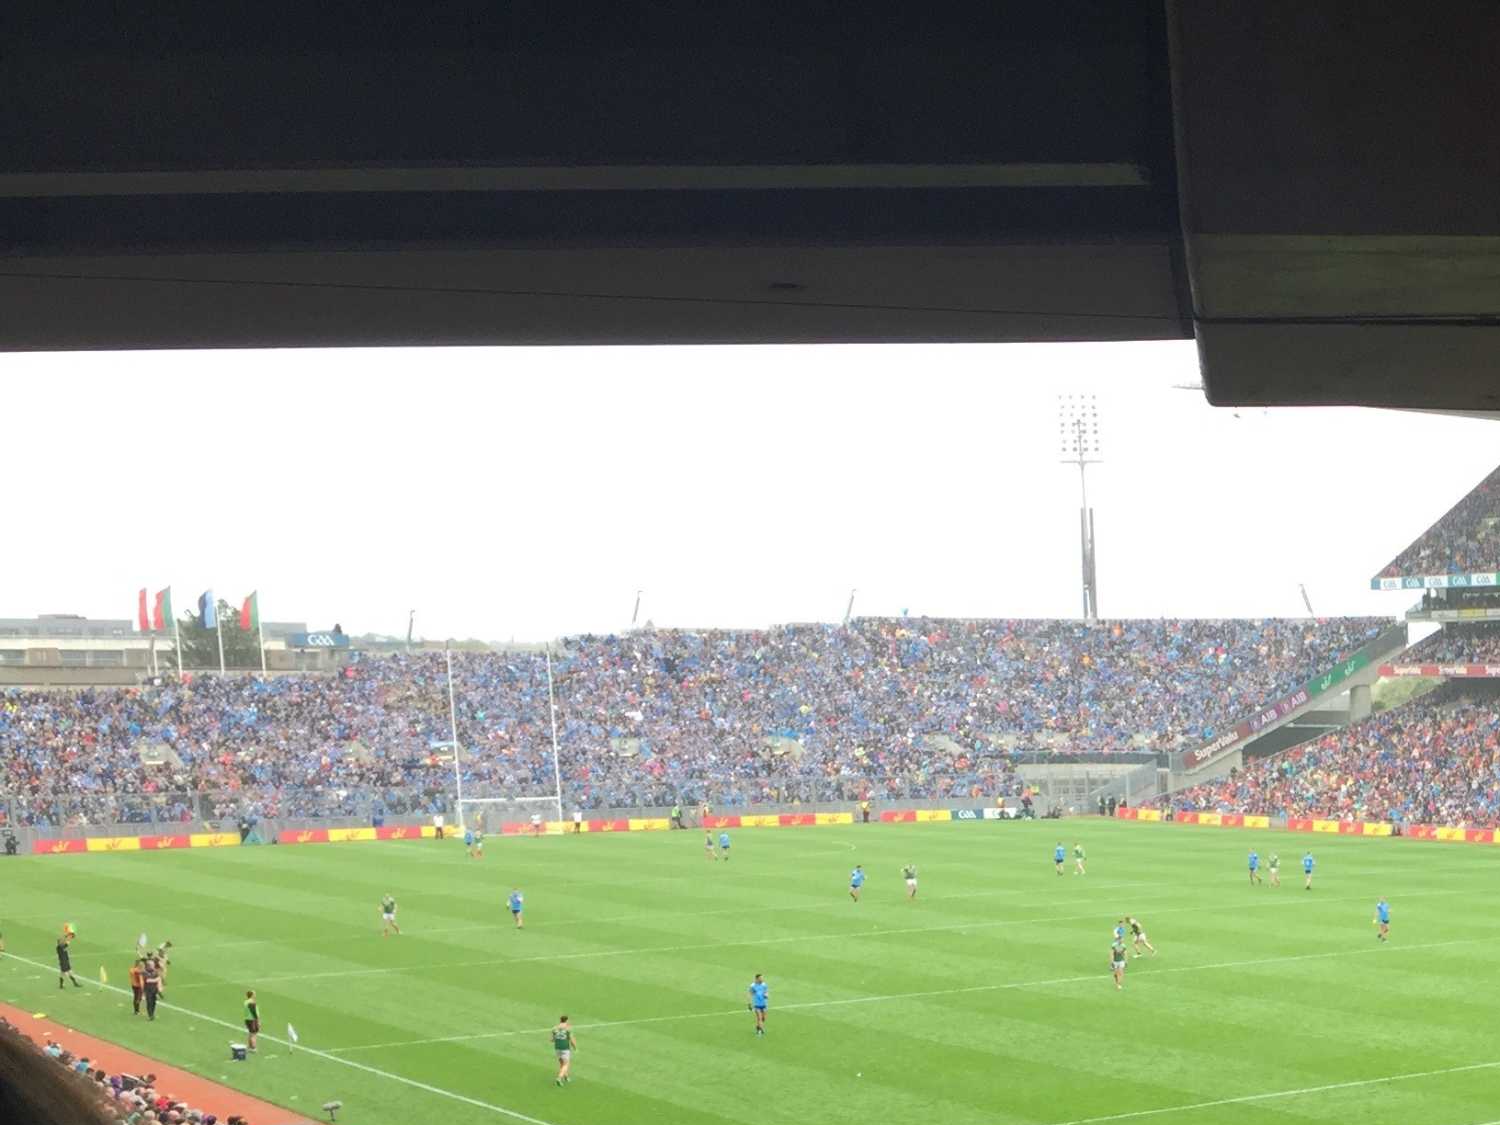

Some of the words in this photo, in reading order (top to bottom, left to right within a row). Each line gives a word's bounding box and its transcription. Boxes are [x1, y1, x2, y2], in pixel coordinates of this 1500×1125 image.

[306, 635, 334, 645] GAA
[1194, 731, 1239, 762] SuperValu
[958, 809, 977, 819] GAA
